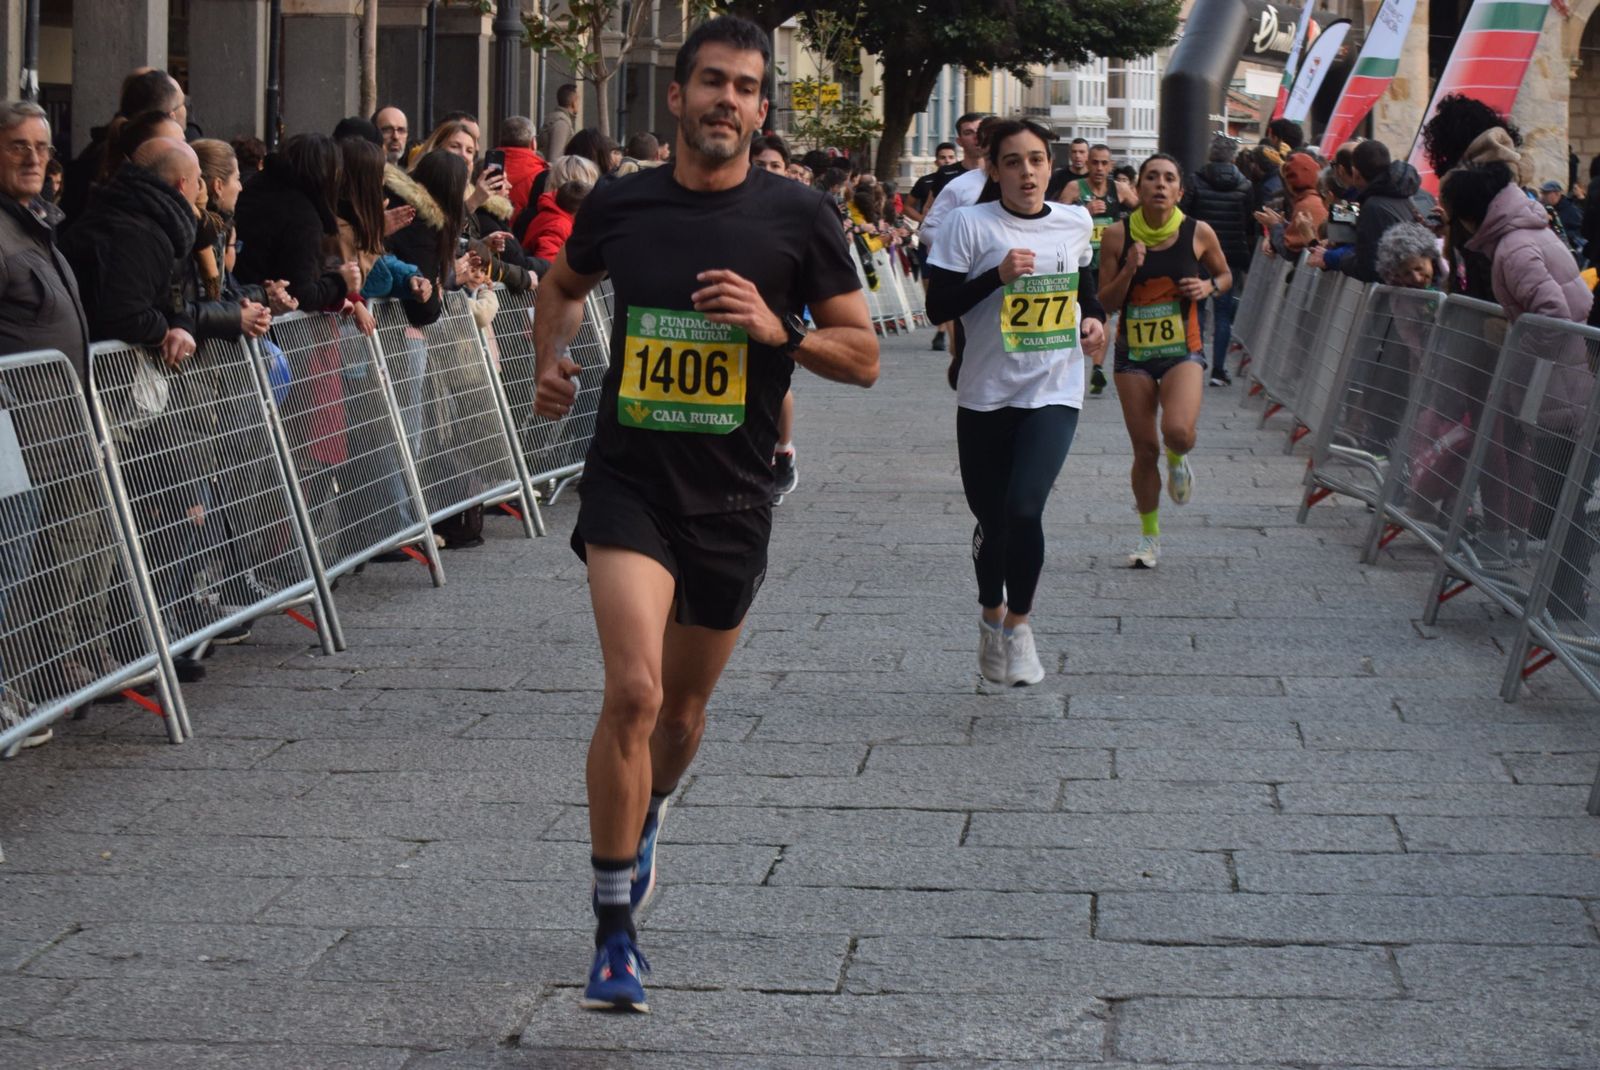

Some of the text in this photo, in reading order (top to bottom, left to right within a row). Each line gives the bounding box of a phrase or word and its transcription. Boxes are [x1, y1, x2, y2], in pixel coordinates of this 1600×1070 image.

[1010, 295, 1069, 327] 277
[659, 326, 732, 341] CAJA RURAL
[1132, 318, 1175, 344] 178
[635, 344, 729, 397] 1406
[652, 409, 738, 425] CAJA RURAL
